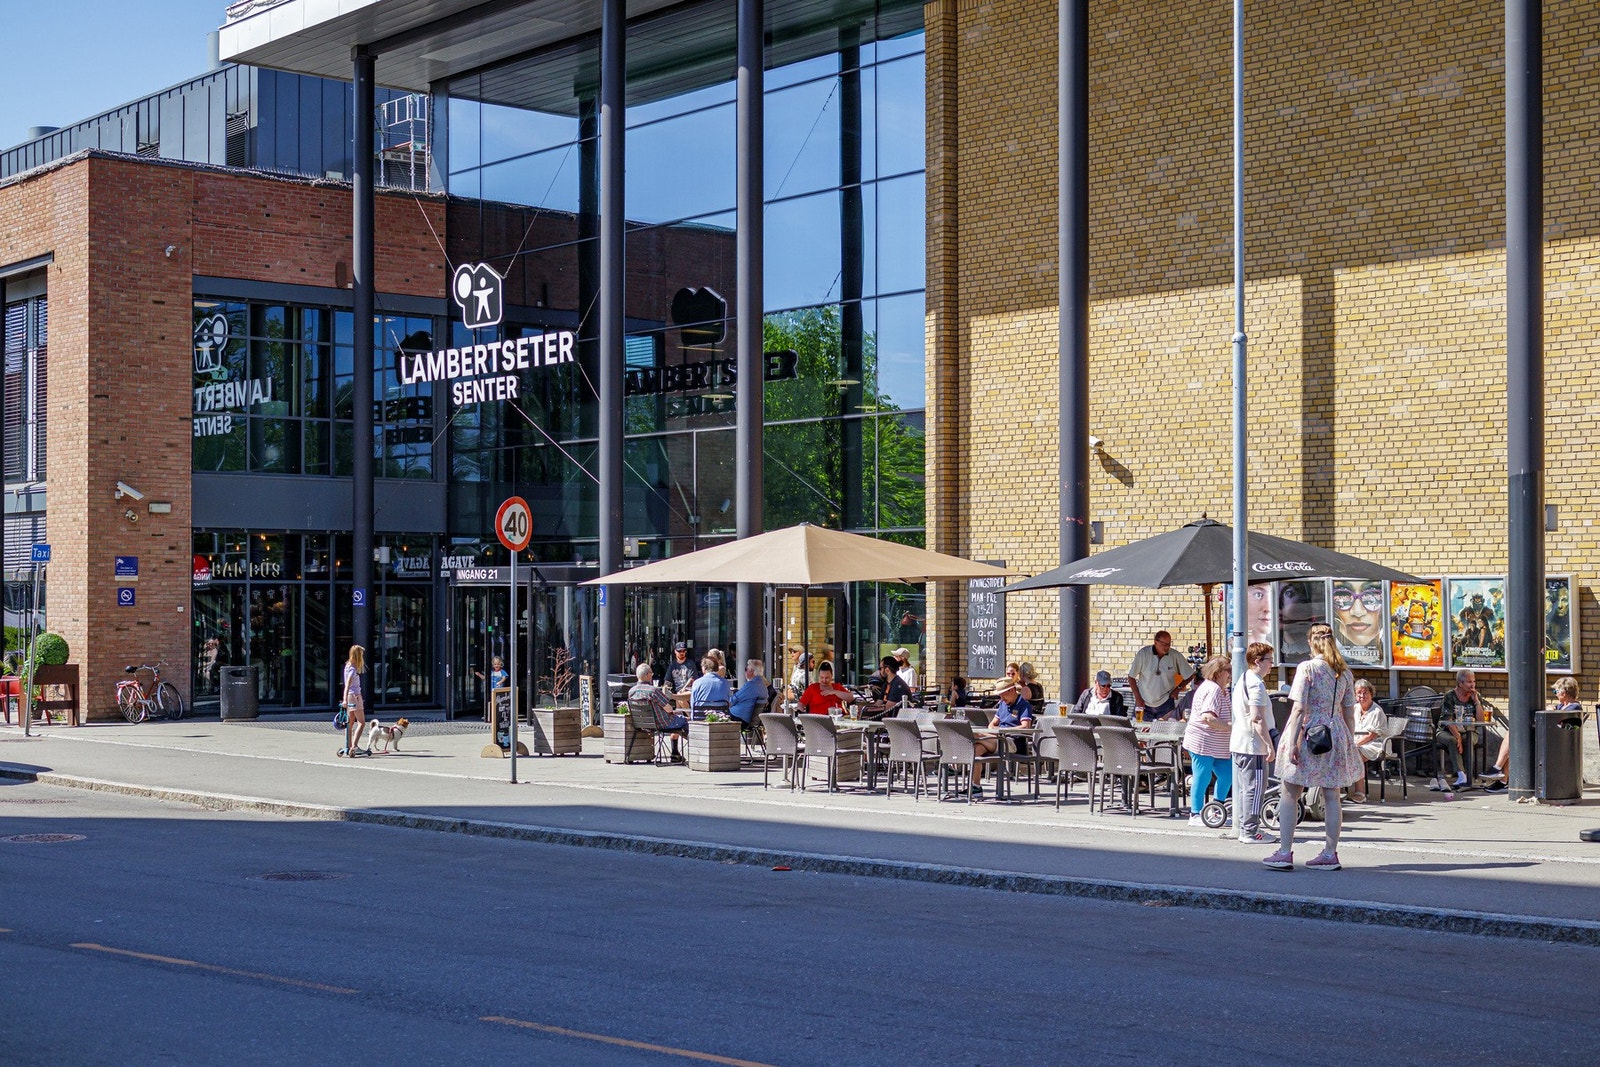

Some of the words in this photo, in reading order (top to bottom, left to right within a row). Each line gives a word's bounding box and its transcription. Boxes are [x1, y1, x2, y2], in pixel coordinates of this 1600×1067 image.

[401, 331, 574, 385] LAMBERTSETER
[453, 375, 518, 406] SENTER
[504, 511, 528, 537] 40
[33, 547, 50, 558] Taxi
[441, 556, 475, 569] AGAVE
[488, 569, 498, 580] 21
[971, 618, 998, 629] LØRDAG
[977, 630, 995, 643] 9-19
[971, 644, 998, 656] SØNDAG
